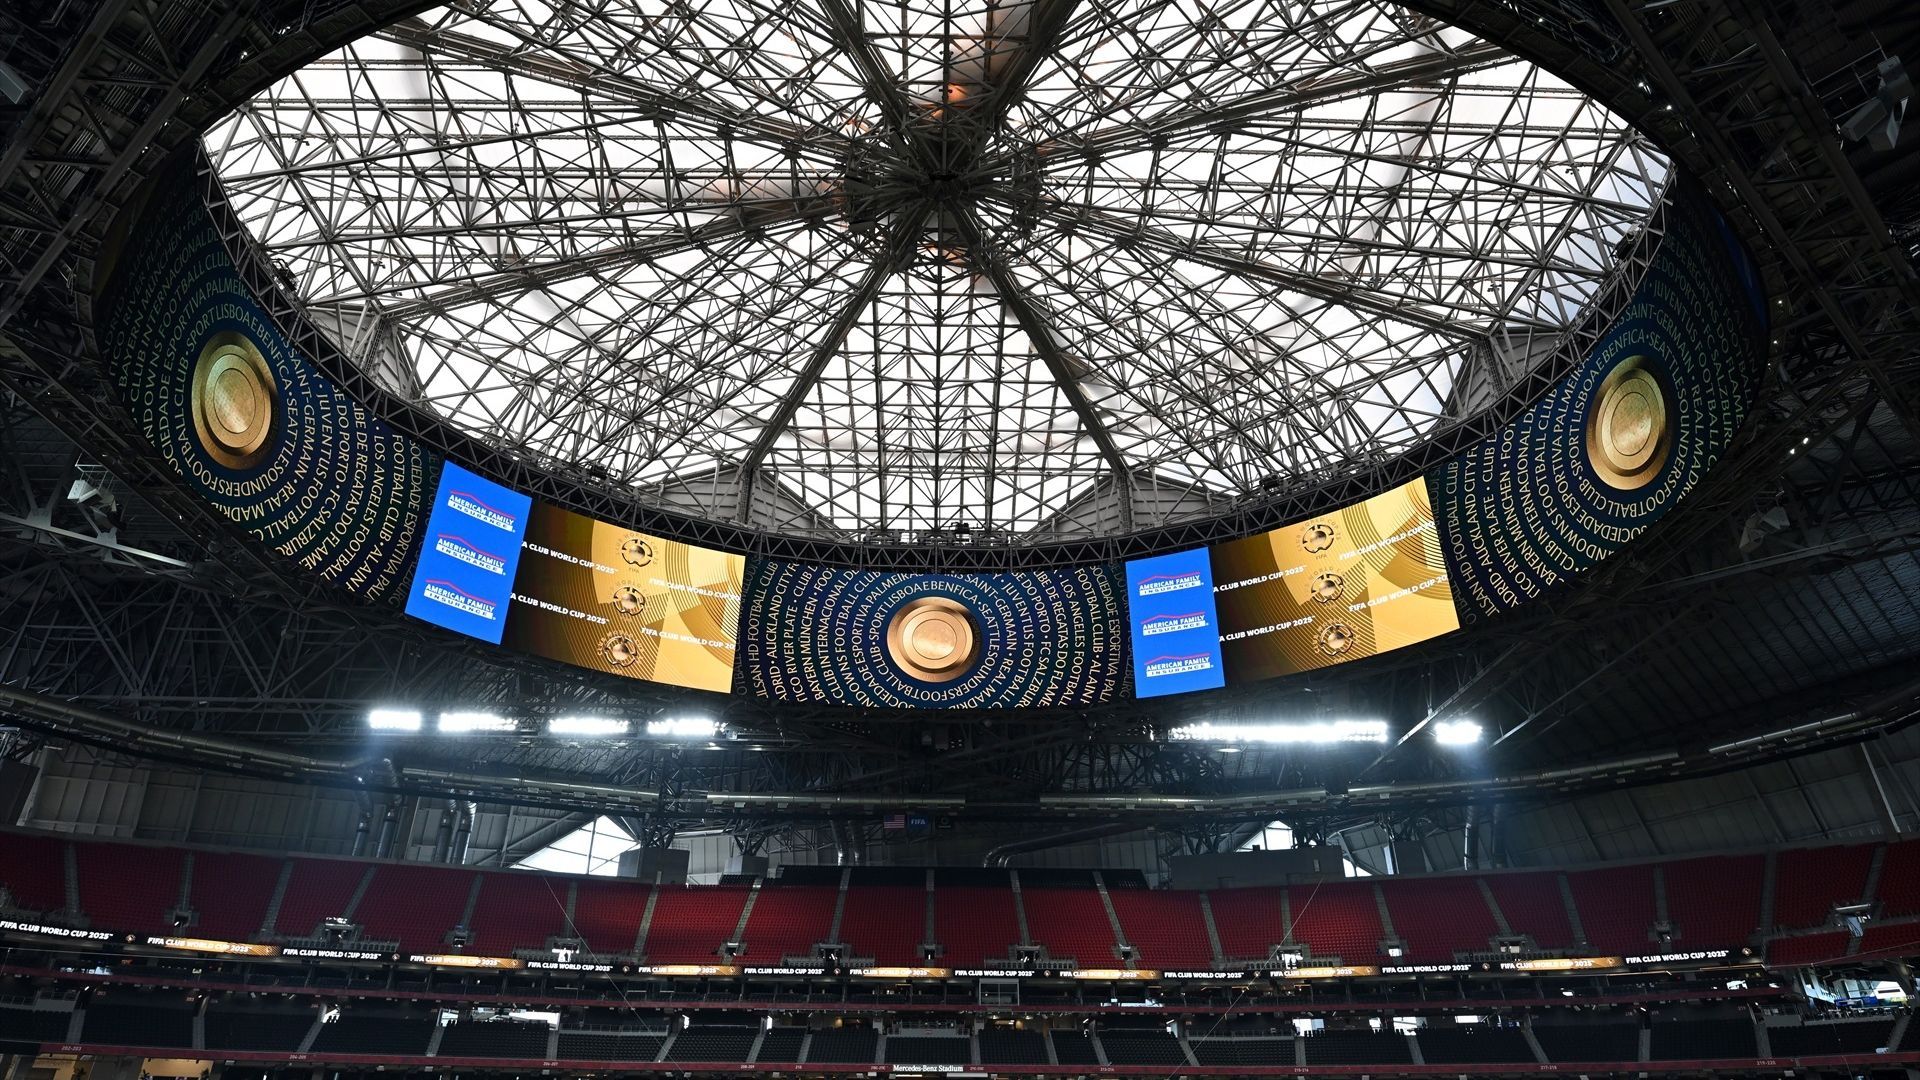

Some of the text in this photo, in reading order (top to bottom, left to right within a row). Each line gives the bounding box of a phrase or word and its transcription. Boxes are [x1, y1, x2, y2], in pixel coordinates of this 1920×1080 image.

[186, 303, 292, 391] SPORT LISBOA BENFICA
[174, 356, 299, 497] SEATTLE SOUNDERS FOOTBALL CLUB
[288, 347, 316, 480] SAINT-GERMAIN
[1569, 328, 1645, 477] SPORT LISBOA BENFICA
[1579, 331, 1689, 518] SEATTLE SOUNDERS FOOTBALL CLUB
[264, 394, 333, 539] JUVENTUS FOOTBALL
[335, 431, 351, 483] PORTO
[1534, 388, 1559, 518] FOOTBALL CLUB
[320, 435, 386, 582] LOS ANGELES FOOTBALL
[345, 453, 368, 515] REGATAS
[379, 434, 405, 542] FOOTBALL CLUB
[449, 494, 514, 526] AMERICAN FAMILY
[1446, 461, 1467, 562] FOOTBALL CLUB
[1516, 431, 1576, 572] CLUB INTERNACIONAL
[452, 503, 508, 529] INSURANCE
[1483, 494, 1518, 573] RIVER PLATE
[437, 538, 505, 568] AMERICAN FAMILY
[441, 547, 498, 572] INSURANCE
[529, 543, 549, 555] CLUB
[550, 550, 578, 564] WORLD
[579, 559, 595, 568] CUP
[1517, 538, 1558, 586] BAYERN
[425, 583, 495, 612] AMERICAN FAMILY
[429, 592, 487, 616] INSURANCE
[518, 595, 539, 607] CLUB
[540, 601, 568, 615] WORLD
[569, 610, 586, 619] CUP
[1022, 579, 1051, 633] DO PORTO
[1139, 575, 1200, 590] AMERICAN FAMILY
[1144, 582, 1196, 594] INSURANCE
[1220, 582, 1239, 591] CLUB
[1240, 575, 1267, 587] WORLD
[1268, 571, 1284, 580] CUP
[1349, 580, 1435, 612] FIFA CLUB WORLD CUP
[641, 627, 724, 648] FIFA CLUB WORLD CUP
[748, 561, 779, 661] HD FOOTBALL CLUB
[784, 572, 812, 674] RIVER PLATE CLUB
[835, 571, 881, 652] FOOTBALL CLUB
[852, 604, 871, 664] ESPORTIVA
[869, 606, 889, 641] SPORT
[884, 583, 922, 609] LISBOA
[930, 580, 978, 605] BENFICA
[964, 574, 1017, 651] SAINT-GERMAIN
[1045, 586, 1068, 669] DE REGATAS DO
[1074, 568, 1104, 653] FOOTBALL CLUB
[1143, 615, 1205, 630] AMERICAN FAMILY
[1148, 623, 1201, 634] INSURANCE
[1226, 631, 1246, 641] CLUB
[1247, 625, 1275, 637] WORLD
[1275, 621, 1291, 630] CUP
[798, 597, 825, 700] BAYERN MÜNCHEN
[818, 580, 848, 699] CLUB INTERNACIONAL
[870, 603, 1000, 702] SEATTLE SOUNDERS FOOTBALL CLUB
[999, 582, 1034, 702] JUVENTUS FOOTBALL
[1040, 641, 1051, 655] FC
[1058, 579, 1085, 706] LOS ANGELES FOOTBALL
[1106, 619, 1121, 676] ESPORTIVA
[1146, 657, 1210, 671] AMERICAN FAMILY
[995, 658, 1013, 685] REAL
[1151, 664, 1205, 675] INSURANCE
[0, 920, 17, 930] FIFA
[18, 923, 40, 932] CLUB
[40, 926, 70, 936] WORLD
[70, 930, 88, 938] CUP
[1414, 965, 1438, 973] WORLD
[1625, 956, 1642, 964] FIFA
[1642, 955, 1661, 963] CLUB
[1662, 953, 1689, 962] WORLD
[893, 1064, 937, 1072] Mercedes-Benz
[938, 1064, 964, 1072] Stadium
